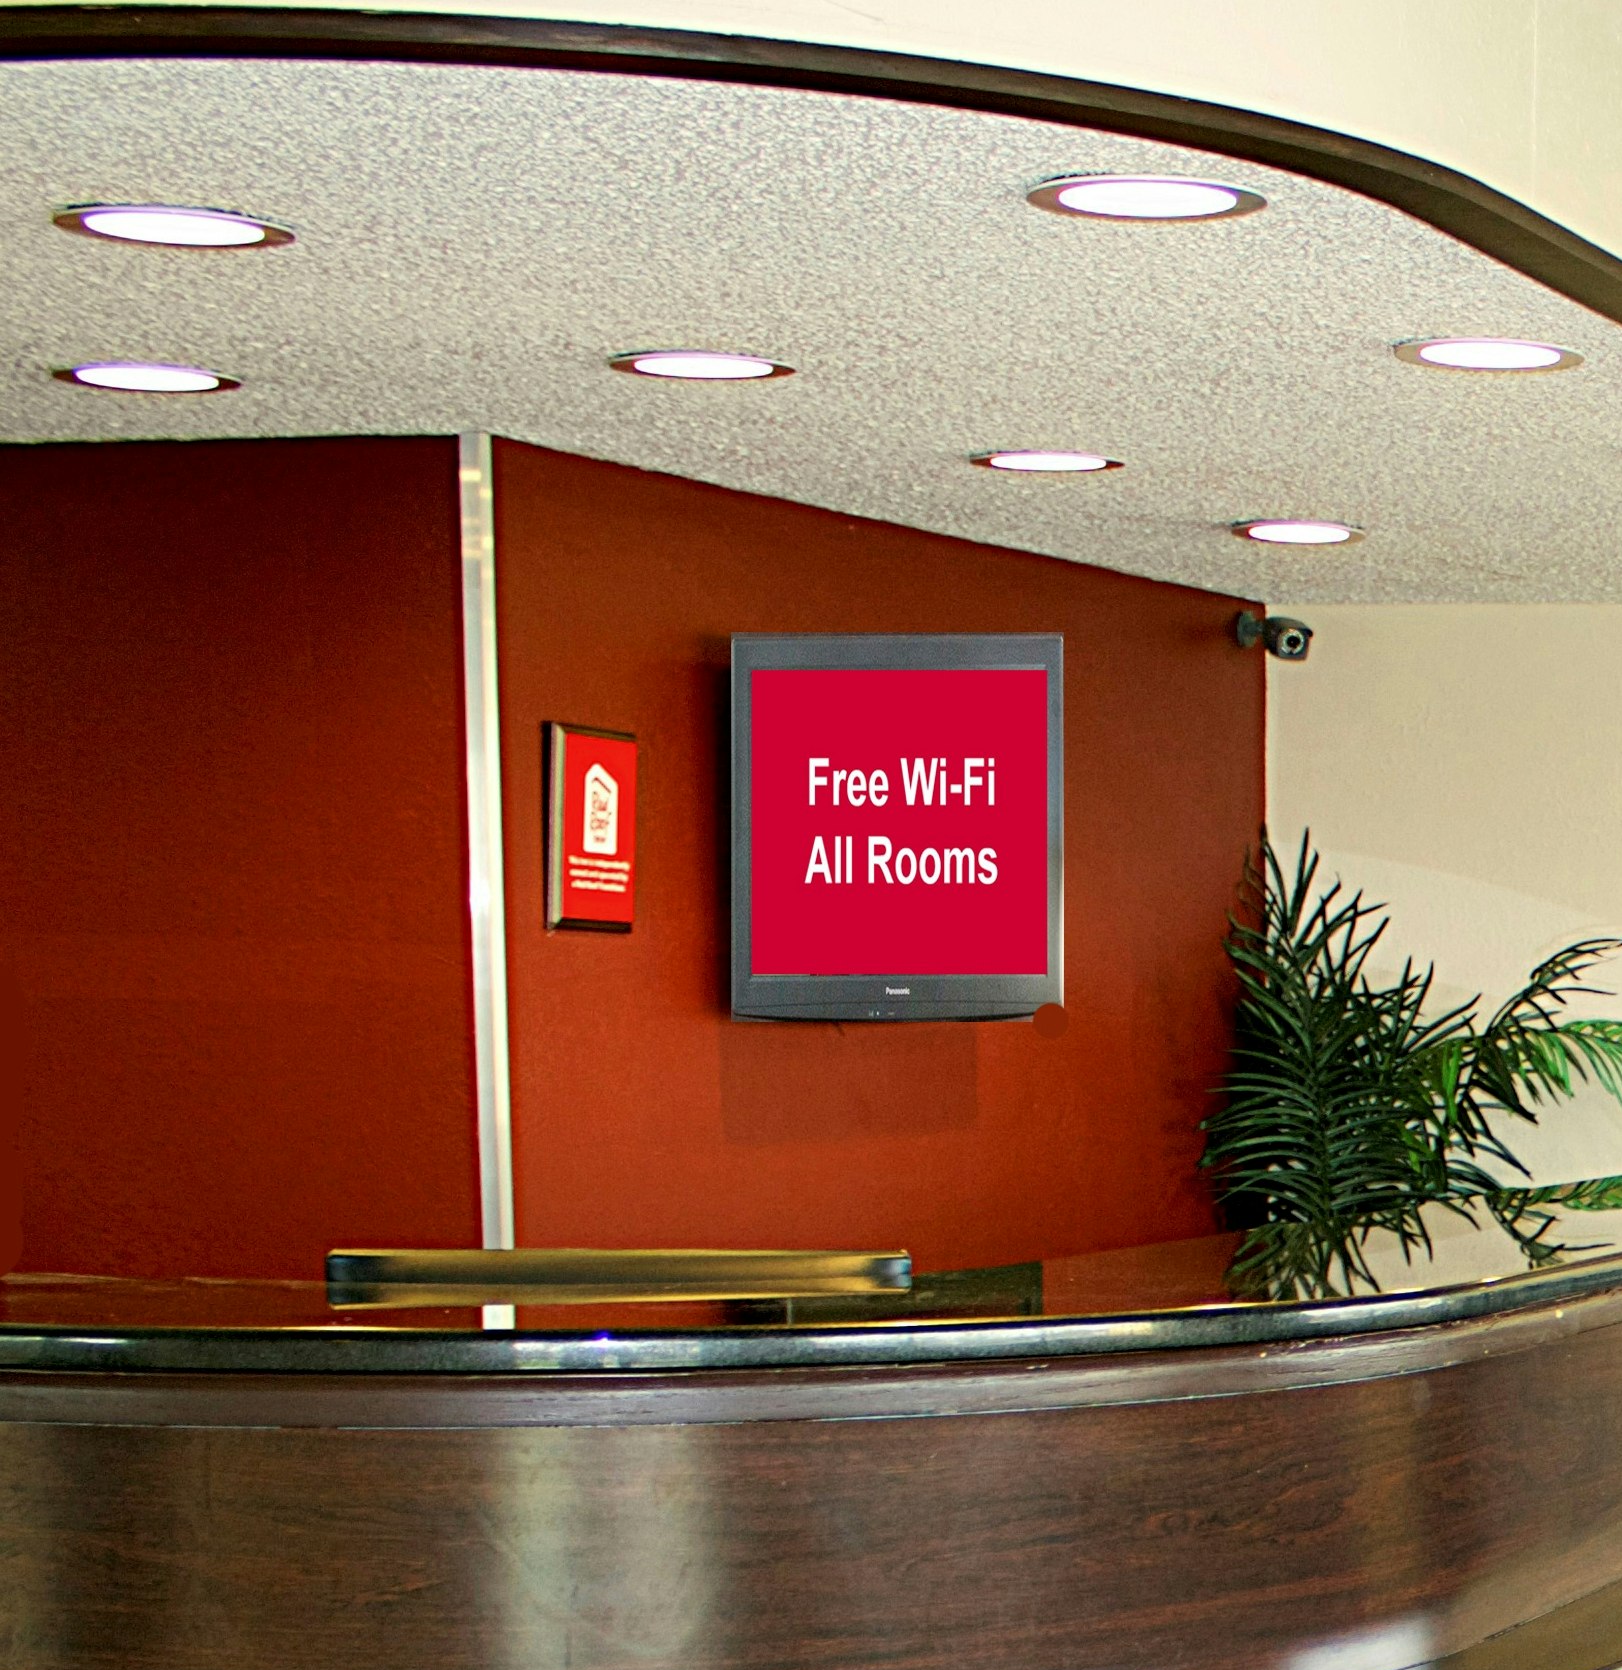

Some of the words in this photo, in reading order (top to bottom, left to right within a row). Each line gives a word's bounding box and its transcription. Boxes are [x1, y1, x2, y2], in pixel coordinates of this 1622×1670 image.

[808, 757, 889, 807] Free
[900, 757, 995, 806] Wi-Fi
[804, 835, 853, 884] All
[867, 835, 998, 885] Rooms
